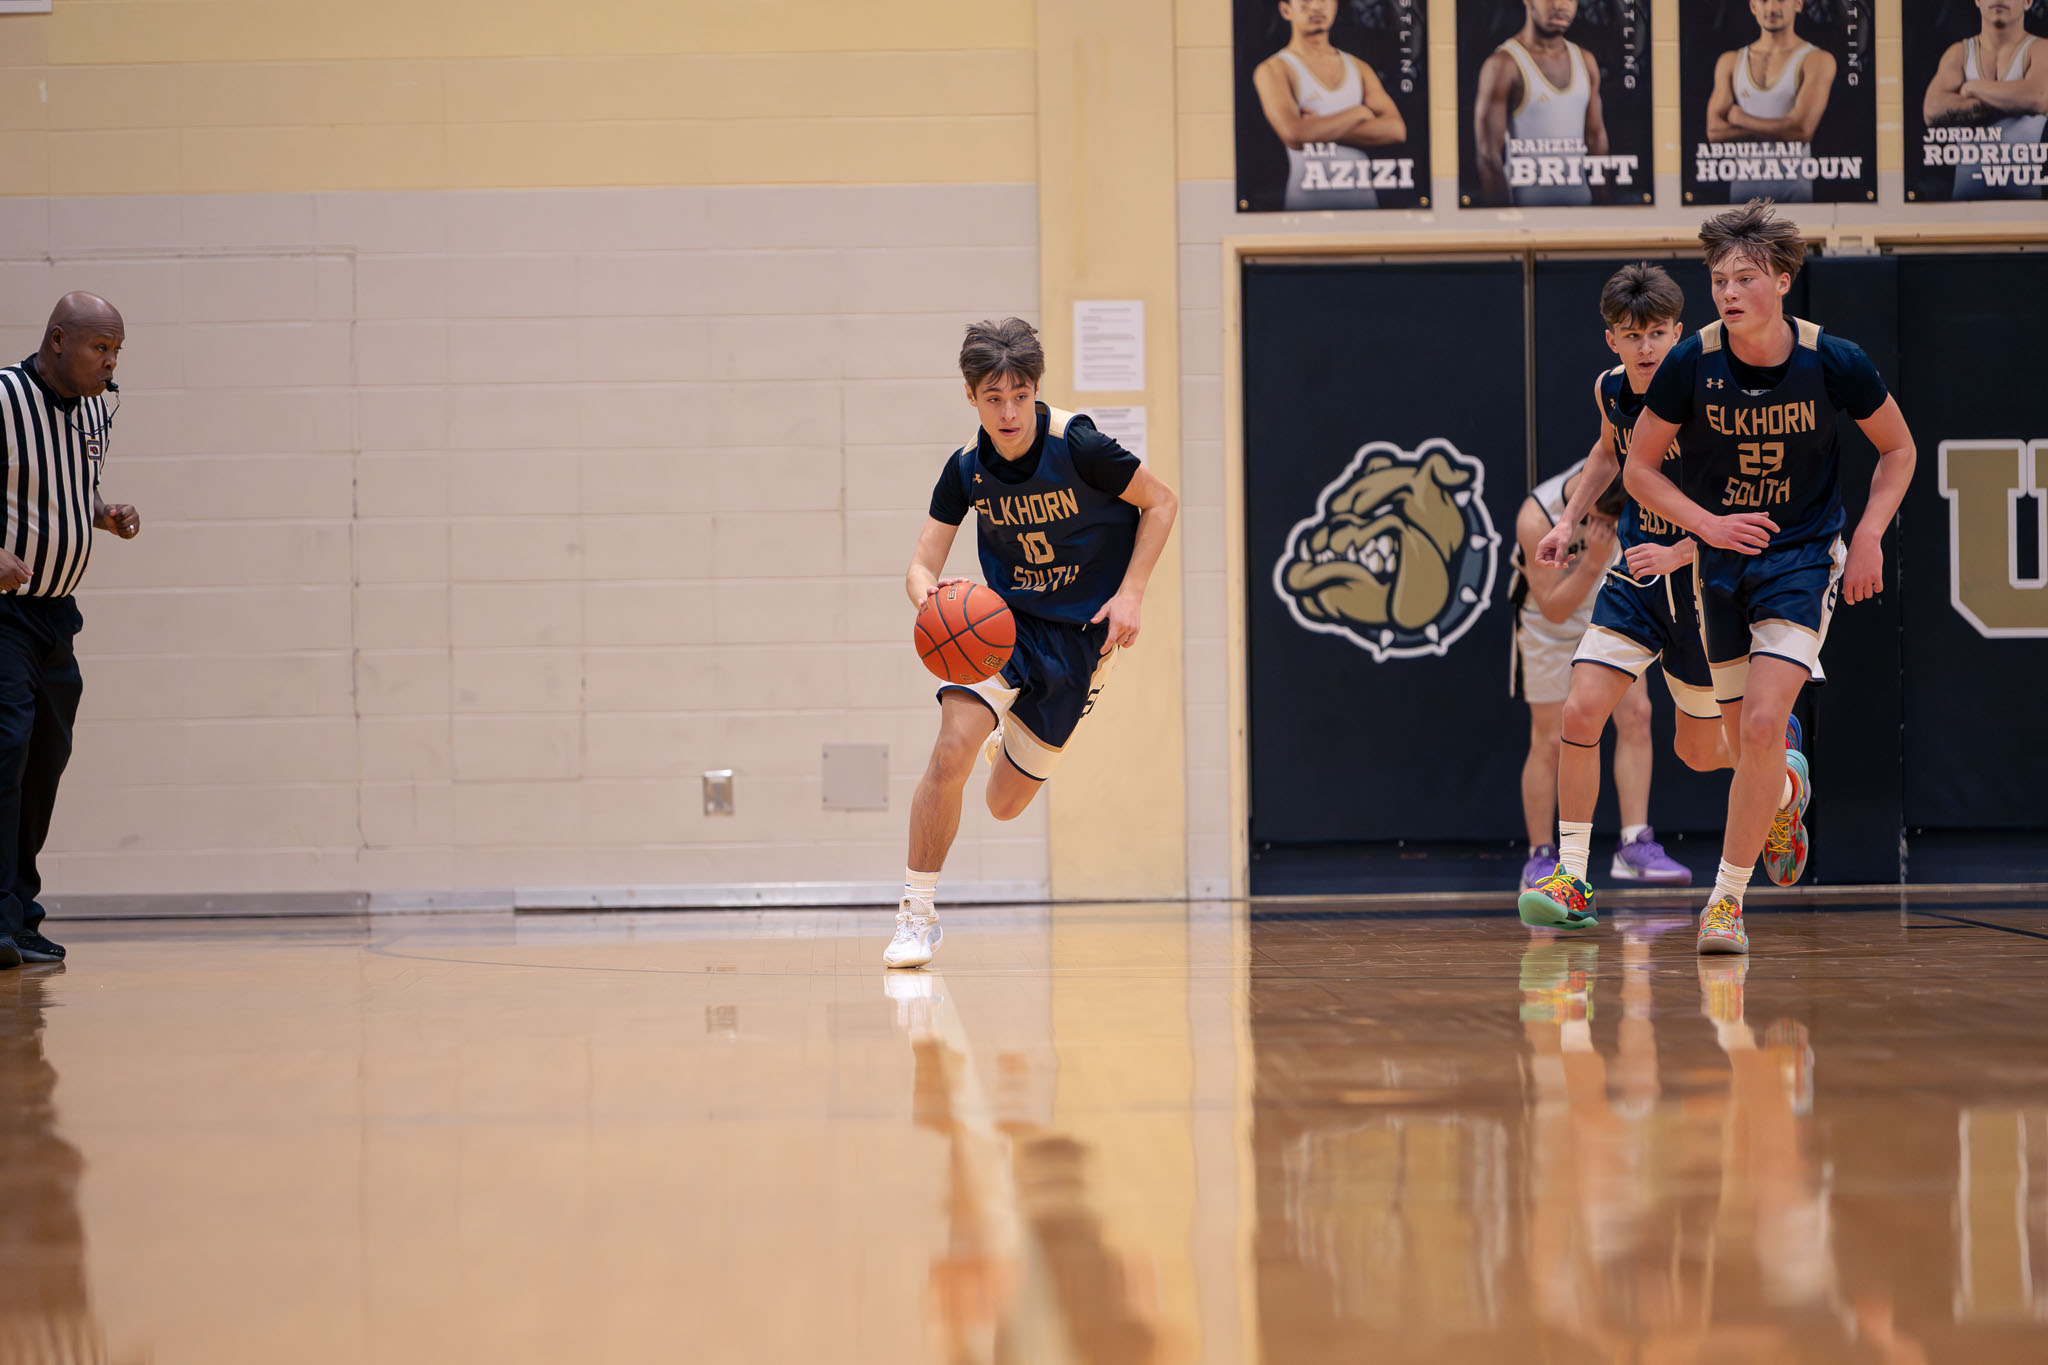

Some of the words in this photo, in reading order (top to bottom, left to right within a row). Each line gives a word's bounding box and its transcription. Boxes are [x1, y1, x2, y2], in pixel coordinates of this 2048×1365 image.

[1302, 141, 1338, 157] ALI
[1510, 138, 1588, 154] RAHZEL
[1922, 126, 2003, 143] JORDAN
[1696, 141, 1803, 159] ABDULLAH
[1922, 142, 2048, 166] RODRIGU
[1301, 158, 1415, 190] AZIZI
[1510, 154, 1639, 186] BRITT
[1696, 156, 1863, 182] HOMAYOUN
[1705, 400, 1816, 436] ELKHORN
[1737, 441, 1785, 477] 23
[975, 487, 1080, 526] ELKHORN
[1721, 476, 1791, 507] SOUTH
[1016, 531, 1056, 565] 10
[1009, 564, 1080, 593] SOUTH
